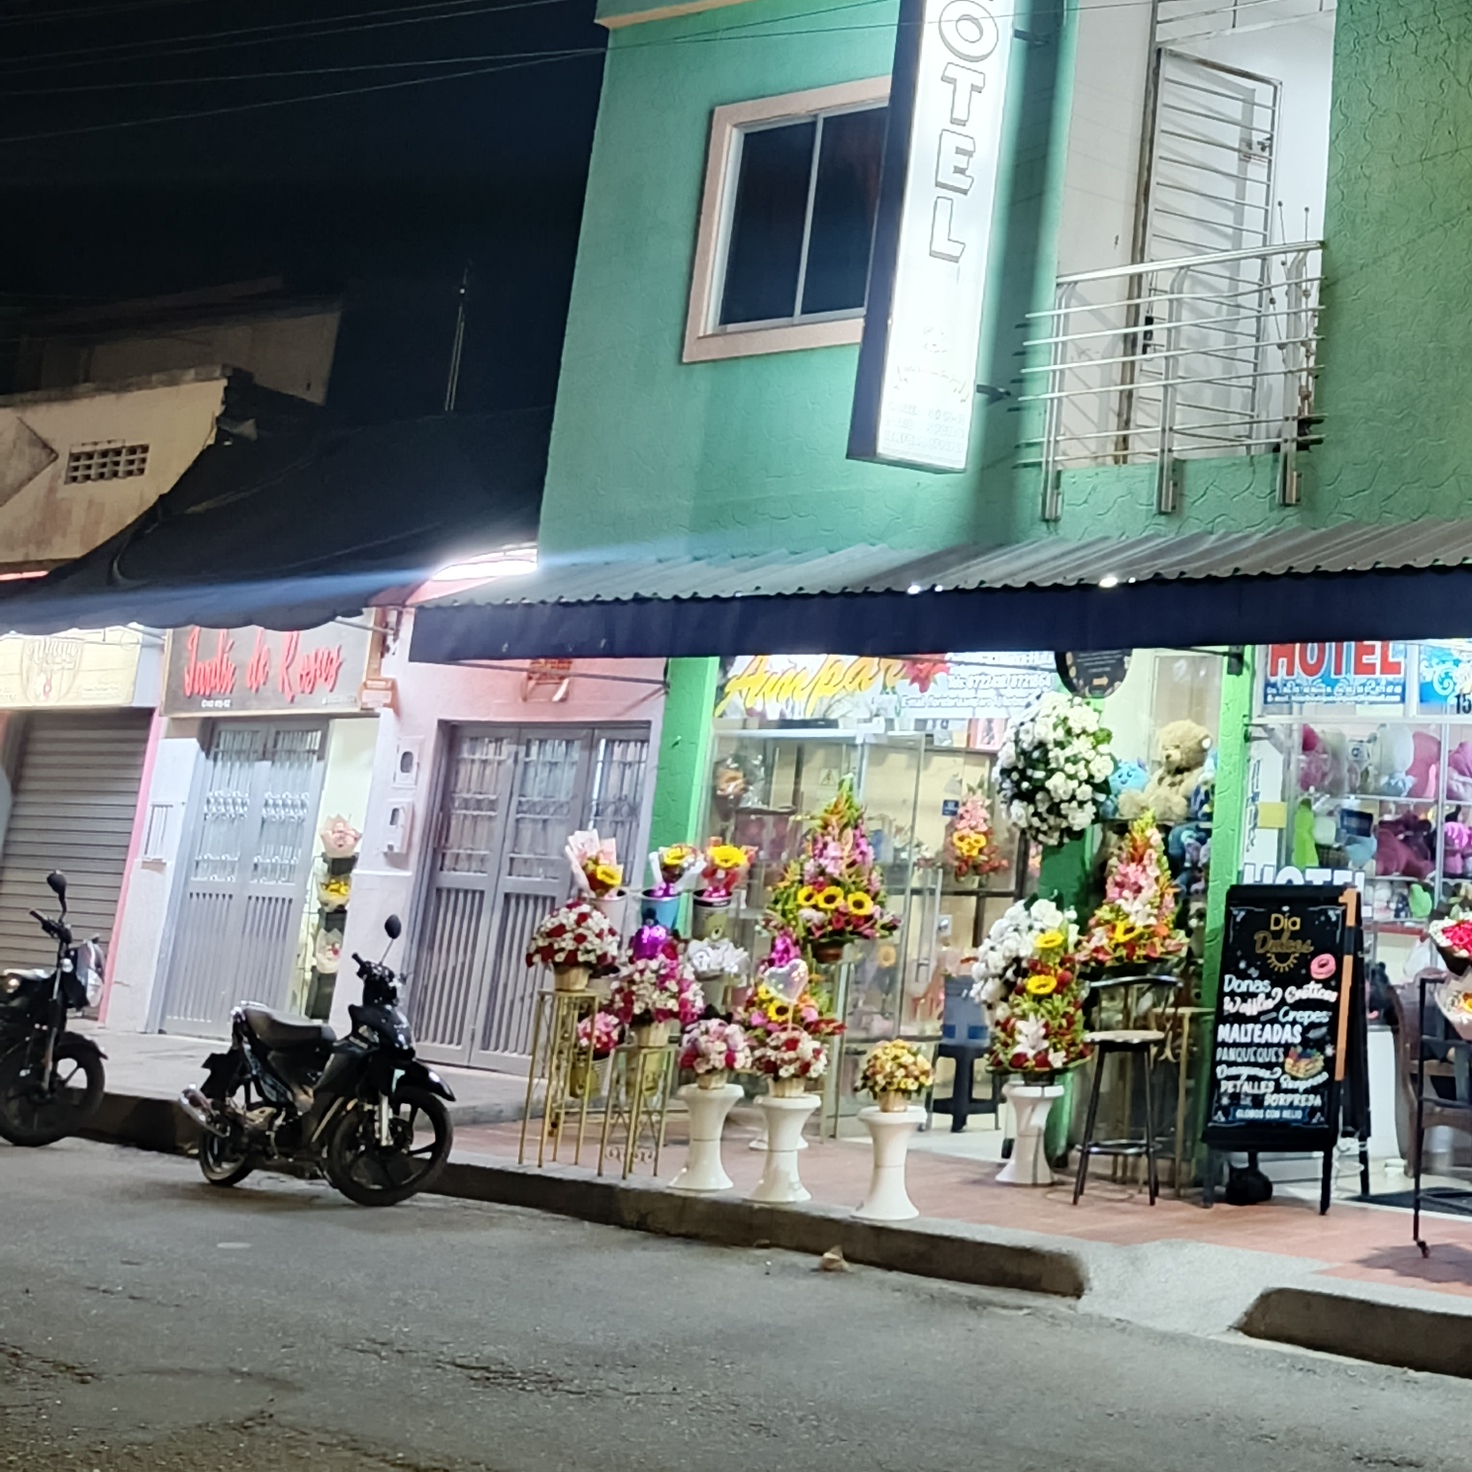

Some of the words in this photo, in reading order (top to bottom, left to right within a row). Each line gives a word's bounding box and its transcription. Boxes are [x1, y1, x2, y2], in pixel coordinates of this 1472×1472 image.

[1223, 974, 1271, 993] Donas
[1279, 1006, 1331, 1026] Crepes
[1217, 1023, 1302, 1044] MALTEADAS
[1216, 1047, 1284, 1062] PANQUEQUES
[1264, 1093, 1322, 1107] SORPRESA
